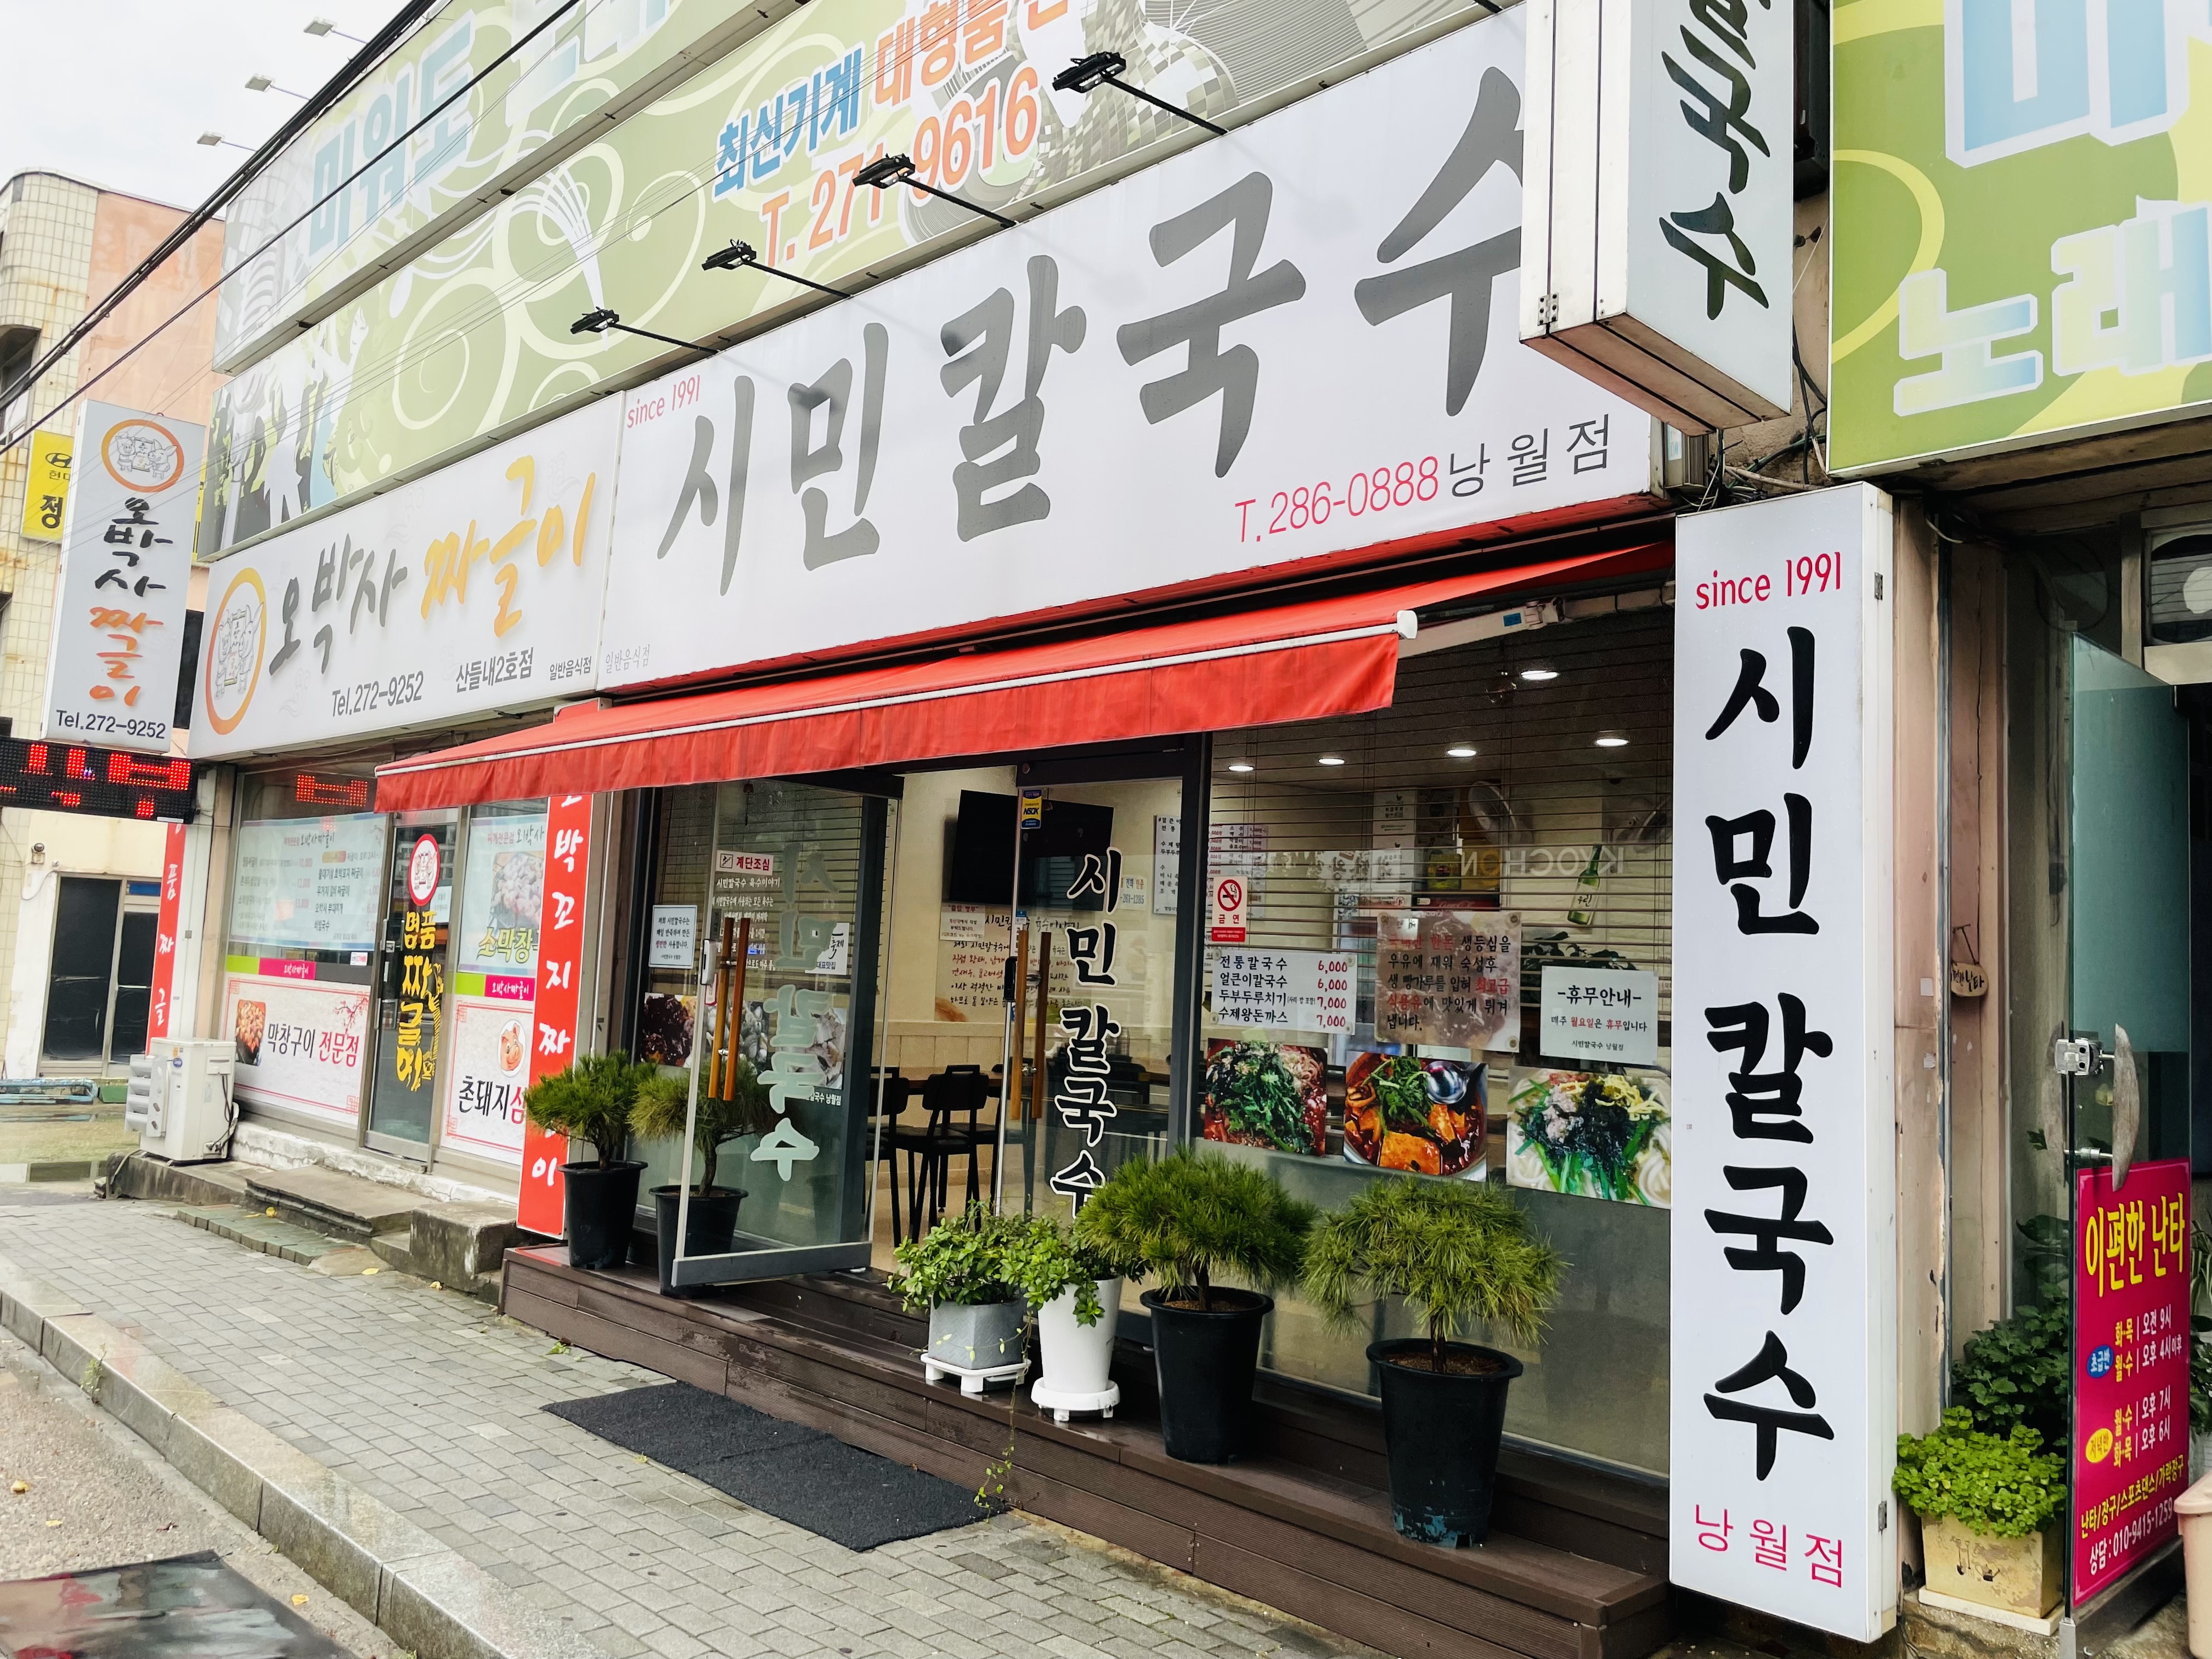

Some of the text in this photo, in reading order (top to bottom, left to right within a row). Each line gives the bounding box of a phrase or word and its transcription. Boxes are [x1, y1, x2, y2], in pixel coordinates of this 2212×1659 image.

[715, 48, 862, 198] 최신기계
[657, 66, 1522, 597] 시민칼국수
[627, 375, 701, 429] since 1991
[1234, 413, 1610, 543] T.286-0888 낭월점
[94, 496, 174, 598] 오박사
[269, 454, 596, 676] 오박사 짜글이
[1695, 551, 1842, 610] since 1991
[456, 647, 533, 693] 산들내2호점
[549, 657, 592, 680] 일반음식점
[332, 672, 424, 718] Tel.272-9252
[56, 709, 166, 741] Tel.272-9252
[516, 825, 545, 846] 오박사
[736, 856, 770, 871] 계단조심
[716, 877, 780, 888] 시민칼국수 육수이야기
[404, 911, 437, 950] 명품
[667, 917, 690, 925] 시민칼국수는
[1218, 914, 1239, 924] 금연
[1461, 935, 1511, 953] 생등심을
[1220, 955, 1347, 974] 전통칼국수 6,000
[1388, 953, 1498, 973] 우유에 재워 숙성후
[1220, 972, 1347, 992] 얼큰이칼국수 6,000
[1387, 973, 1510, 995] 생 빵가루를 입혀 최고급
[1218, 990, 1286, 1007] 두부두루치기
[1317, 996, 1347, 1010] 7,000
[1387, 994, 1508, 1015] 식용유에 맛있게 튀겨
[1218, 1006, 1346, 1029] 수제왕돈까스 7,000
[1387, 1013, 1423, 1031] 냅니다.
[1551, 1015, 1648, 1032] 매주 월요일은 휴무입니다
[268, 1023, 359, 1067] 막창구이 전문점
[1050, 847, 1122, 1220] 시민칼국수
[1571, 1040, 1604, 1049] 시민칼국수
[1703, 626, 1834, 1481] 시민칼국수
[826, 1093, 842, 1106] 낭월점
[2085, 1192, 2186, 1298] 이편한 난타
[2142, 1308, 2157, 1335] 오전
[2160, 1304, 2172, 1330] 9시
[2091, 1347, 2111, 1373] 초급반
[2142, 1340, 2157, 1367] 오후
[2142, 1392, 2157, 1420] 오후
[2159, 1385, 2171, 1412] 7시
[2090, 1430, 2109, 1460] 저녁반
[2141, 1423, 2156, 1451] 오후
[2159, 1414, 2170, 1442] 6시
[1695, 1504, 1844, 1589] 낭월점
